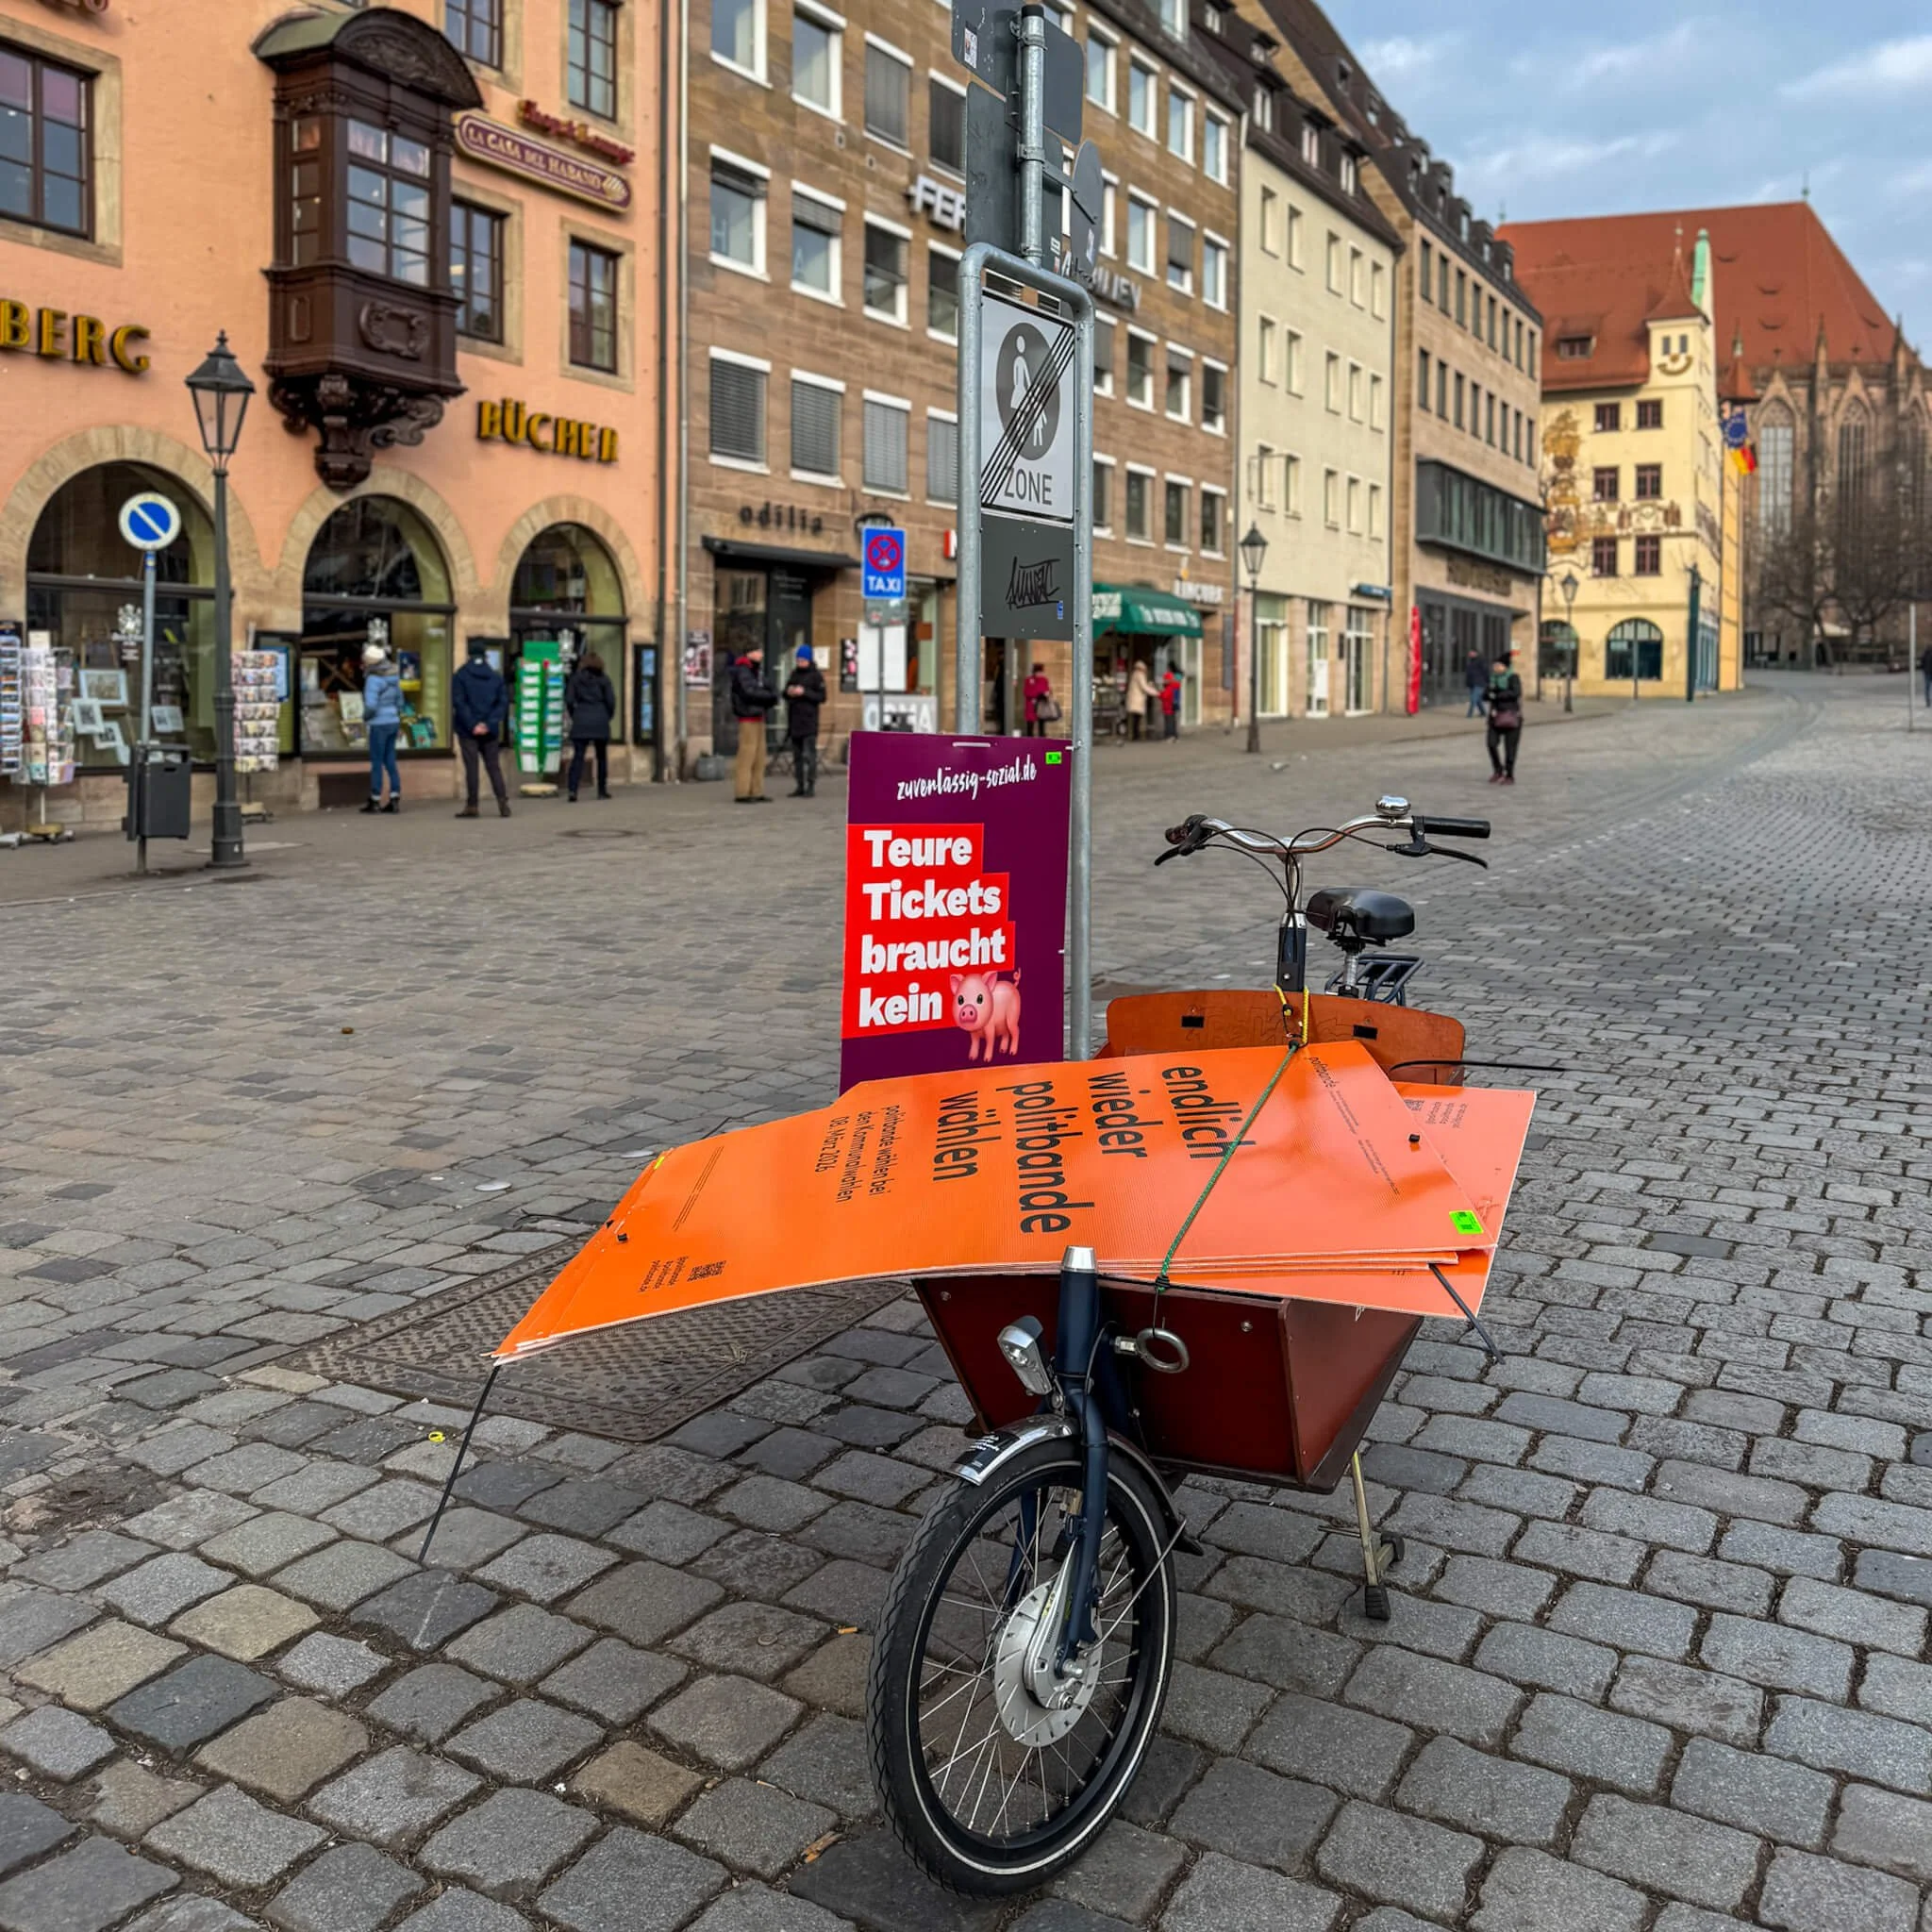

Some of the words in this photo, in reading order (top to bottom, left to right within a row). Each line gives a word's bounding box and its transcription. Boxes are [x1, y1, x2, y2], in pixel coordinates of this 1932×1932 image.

[468, 126, 485, 142] LA
[487, 133, 522, 160] CASA
[0, 298, 151, 375] BERG
[476, 397, 618, 464] BÜCHER
[1004, 468, 1053, 506] ZONE
[740, 500, 823, 535] odilia
[867, 576, 902, 593] TAXI
[896, 754, 1037, 801] zuverlässig-sozial.de
[863, 829, 973, 868] Teure
[862, 878, 1002, 921] Tickets
[860, 927, 1007, 974] braucht
[858, 982, 942, 1028] kein
[856, 1111, 879, 1126] den
[879, 1105, 907, 1147] politbande
[1087, 1072, 1163, 1159] wieder
[1161, 1066, 1256, 1160] endlich
[821, 1126, 846, 1151] März
[932, 1091, 1002, 1181] wählen
[995, 1080, 1095, 1234] politbande
[814, 1150, 841, 1174] 2026
[836, 1124, 875, 1204] Kommunalwahlen
[873, 1146, 898, 1179] wählen
[869, 1179, 895, 1196] bei
